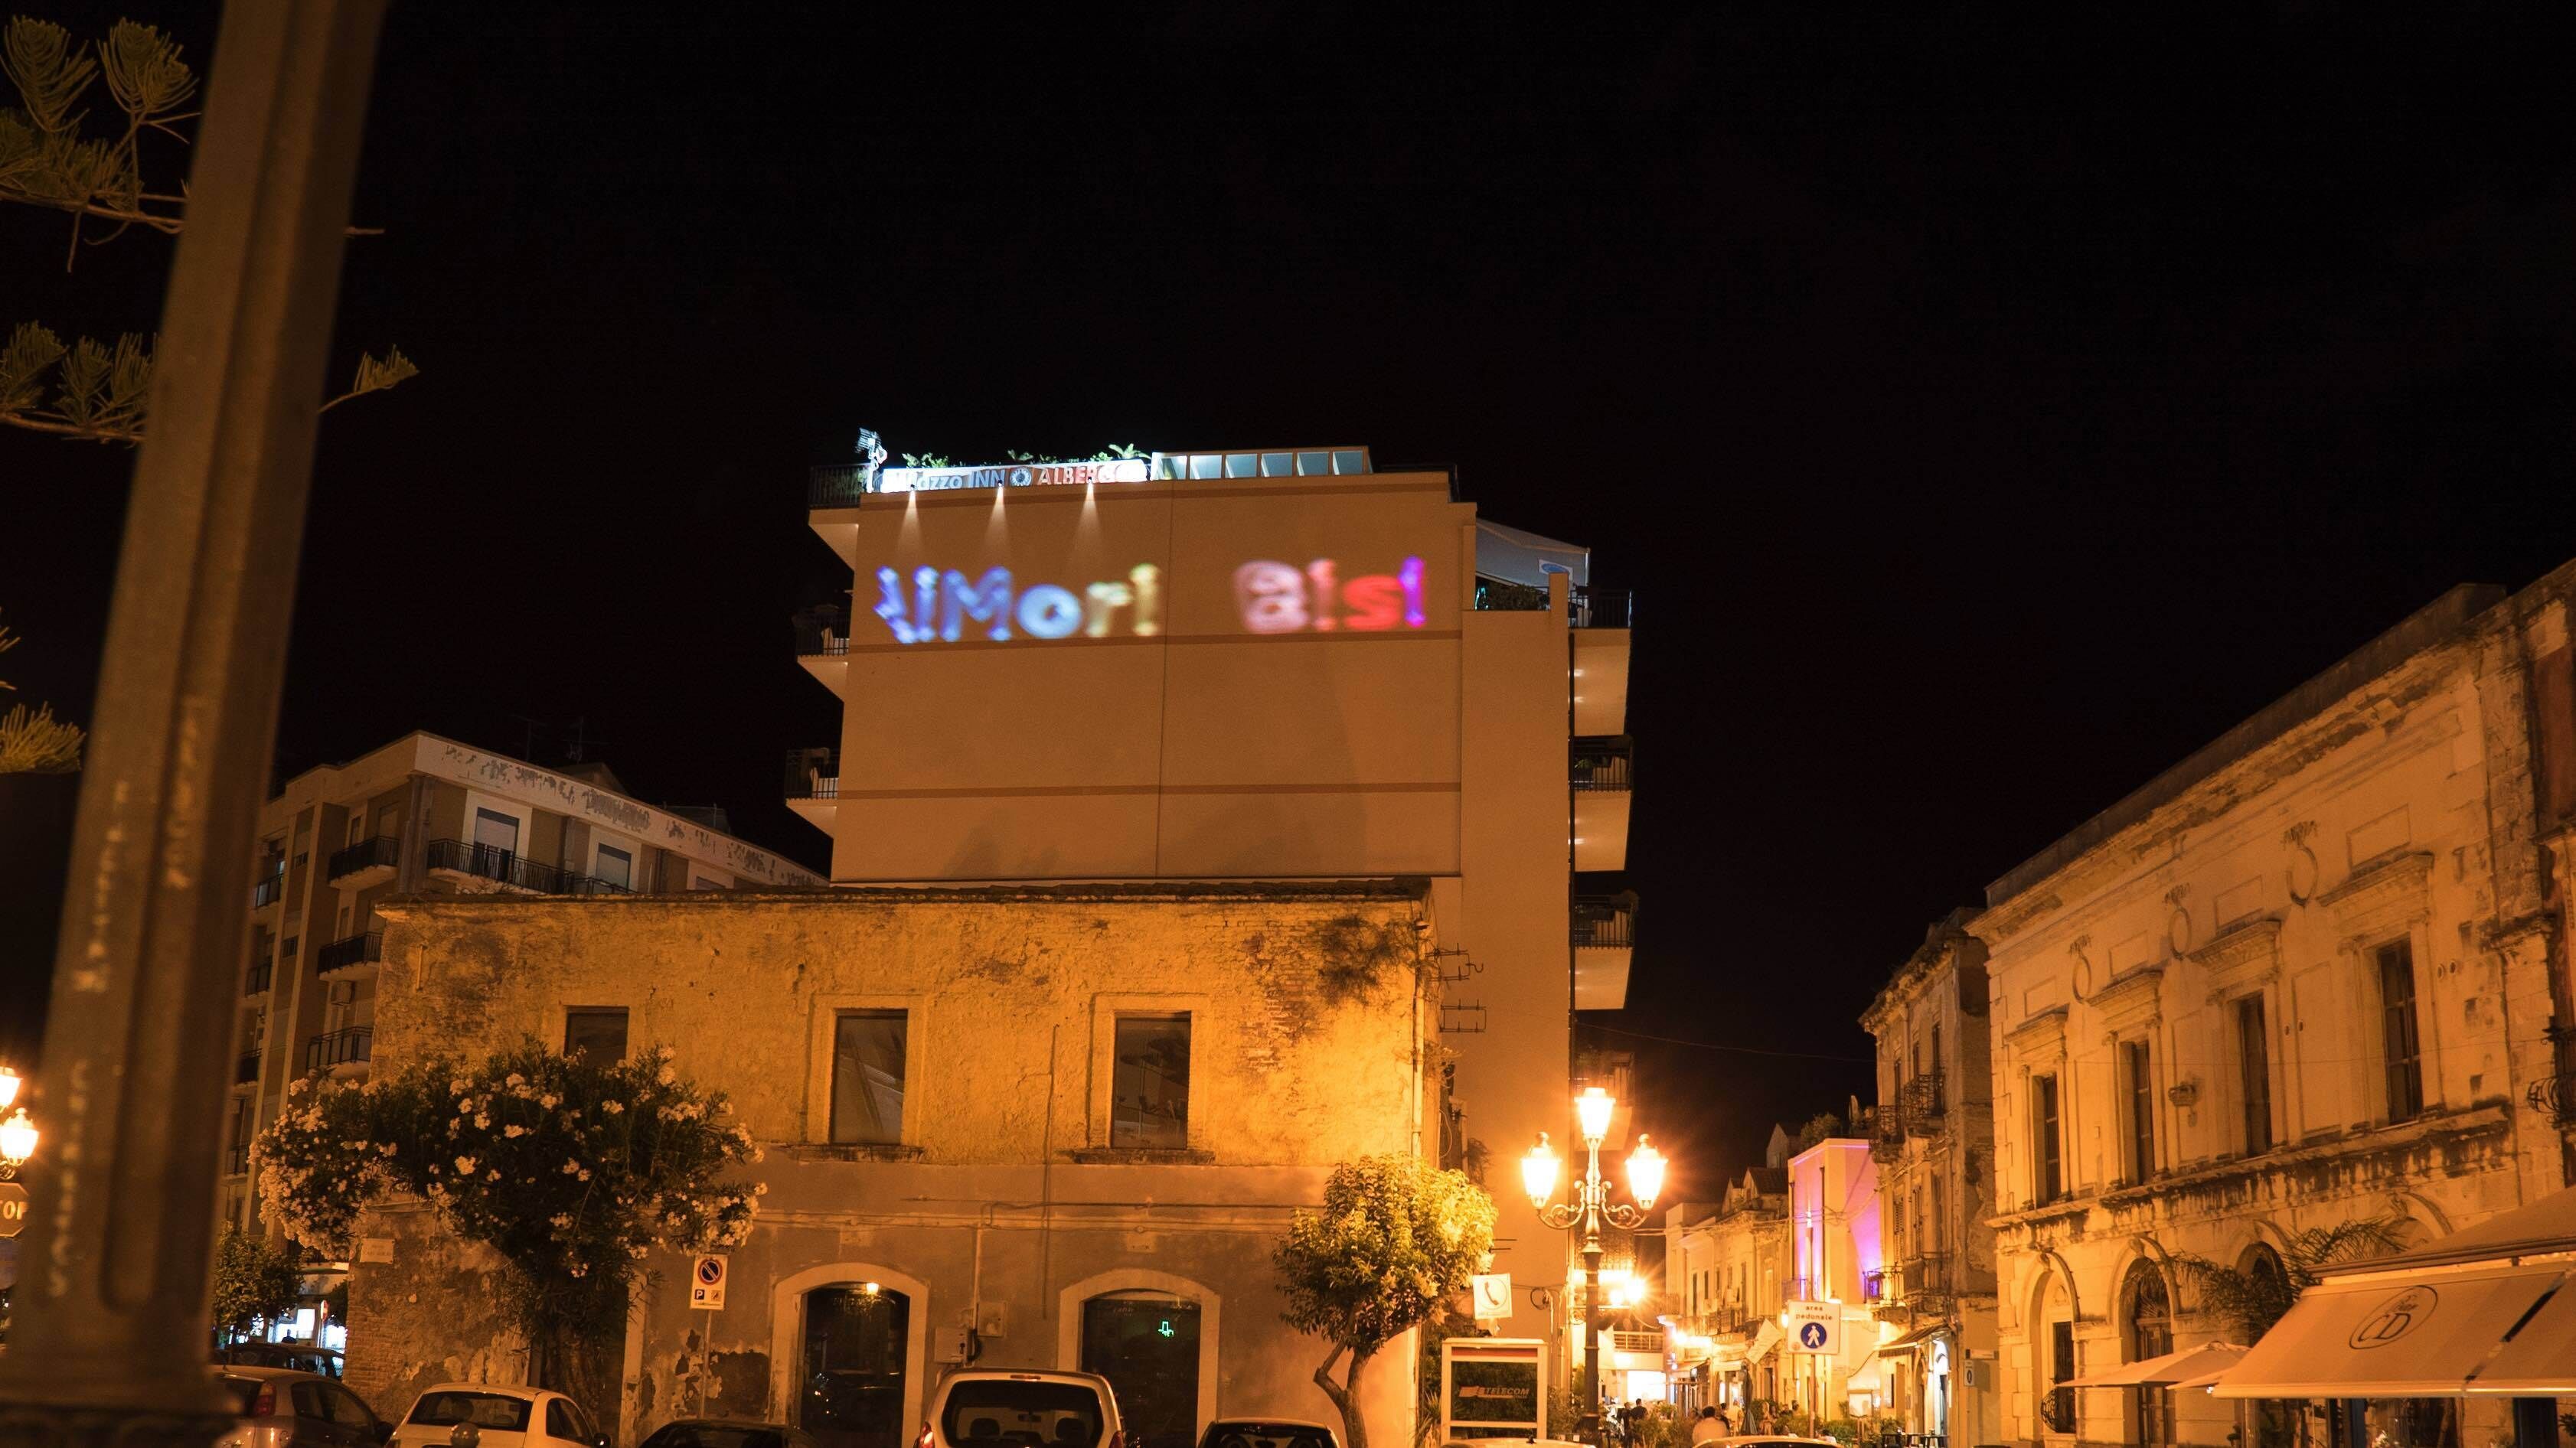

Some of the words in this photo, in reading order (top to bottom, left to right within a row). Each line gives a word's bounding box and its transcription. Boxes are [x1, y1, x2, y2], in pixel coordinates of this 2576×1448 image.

[968, 468, 1006, 488] INN
[696, 1290, 703, 1300] P
[1485, 1387, 1530, 1396] TELECOM
